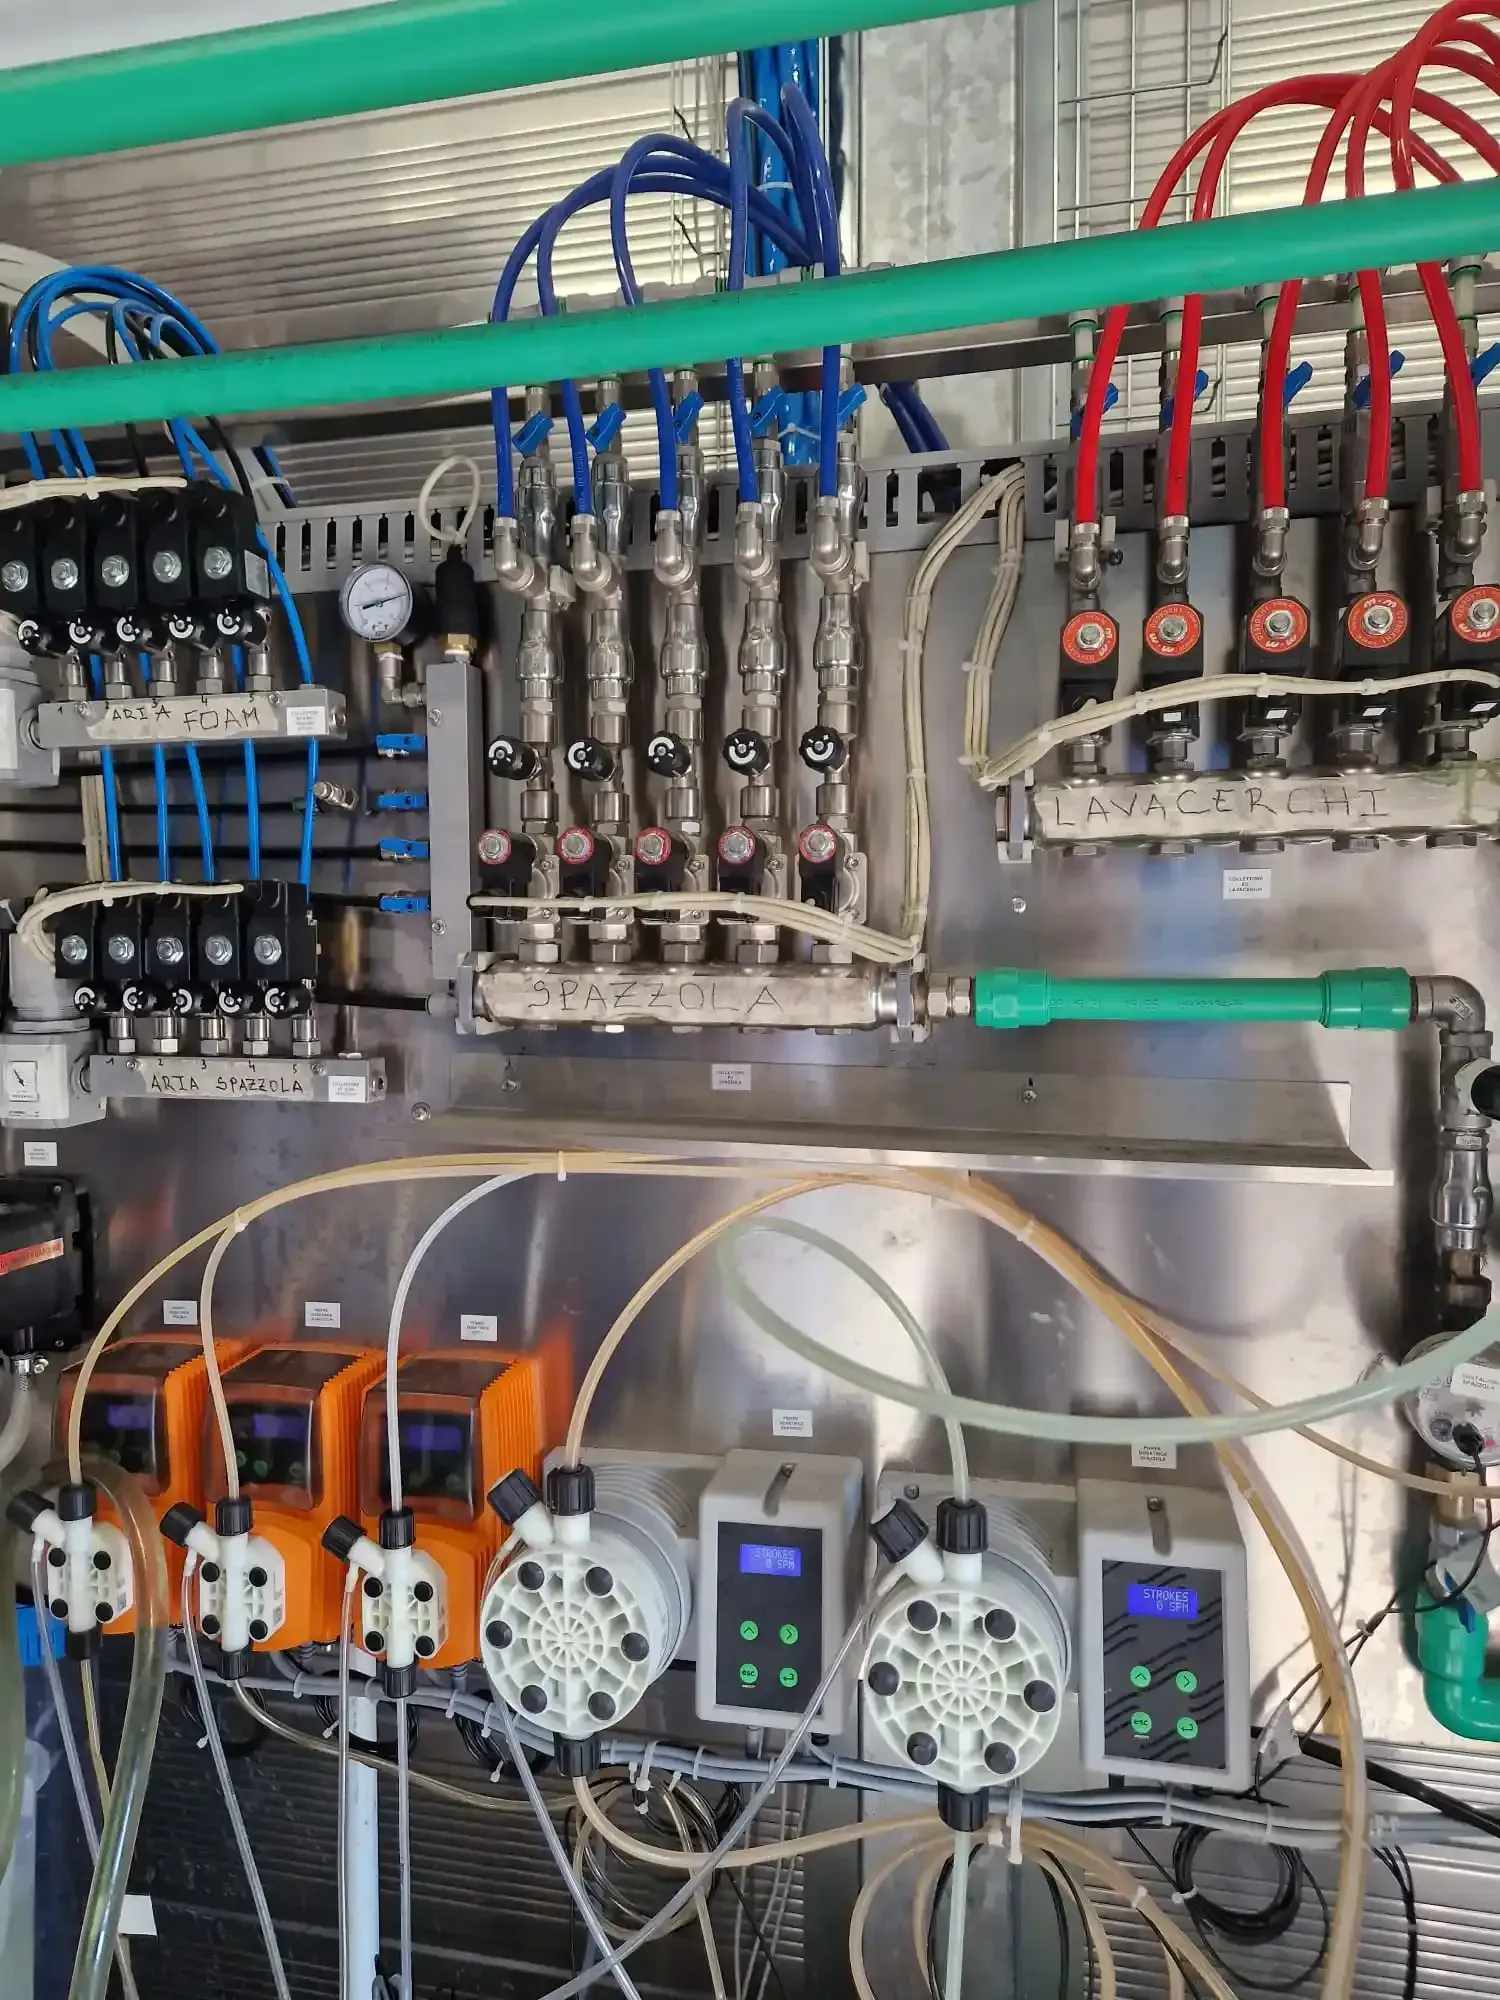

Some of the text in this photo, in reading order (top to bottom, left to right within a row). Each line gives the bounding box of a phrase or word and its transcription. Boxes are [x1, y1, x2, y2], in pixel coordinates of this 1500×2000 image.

[201, 696, 208, 706] 4
[111, 704, 260, 732] ARIA FOAM
[1054, 786, 1390, 826] LAVACERCHI
[528, 980, 784, 1014] SPAZZOLA
[200, 1058, 207, 1070] 3
[248, 1060, 255, 1072] 4
[151, 1075, 303, 1093] ARIA SPAZZOLA
[776, 1559, 795, 1569] SPM
[1143, 1588, 1189, 1602] STROKES
[1169, 1601, 1189, 1613] SPM
